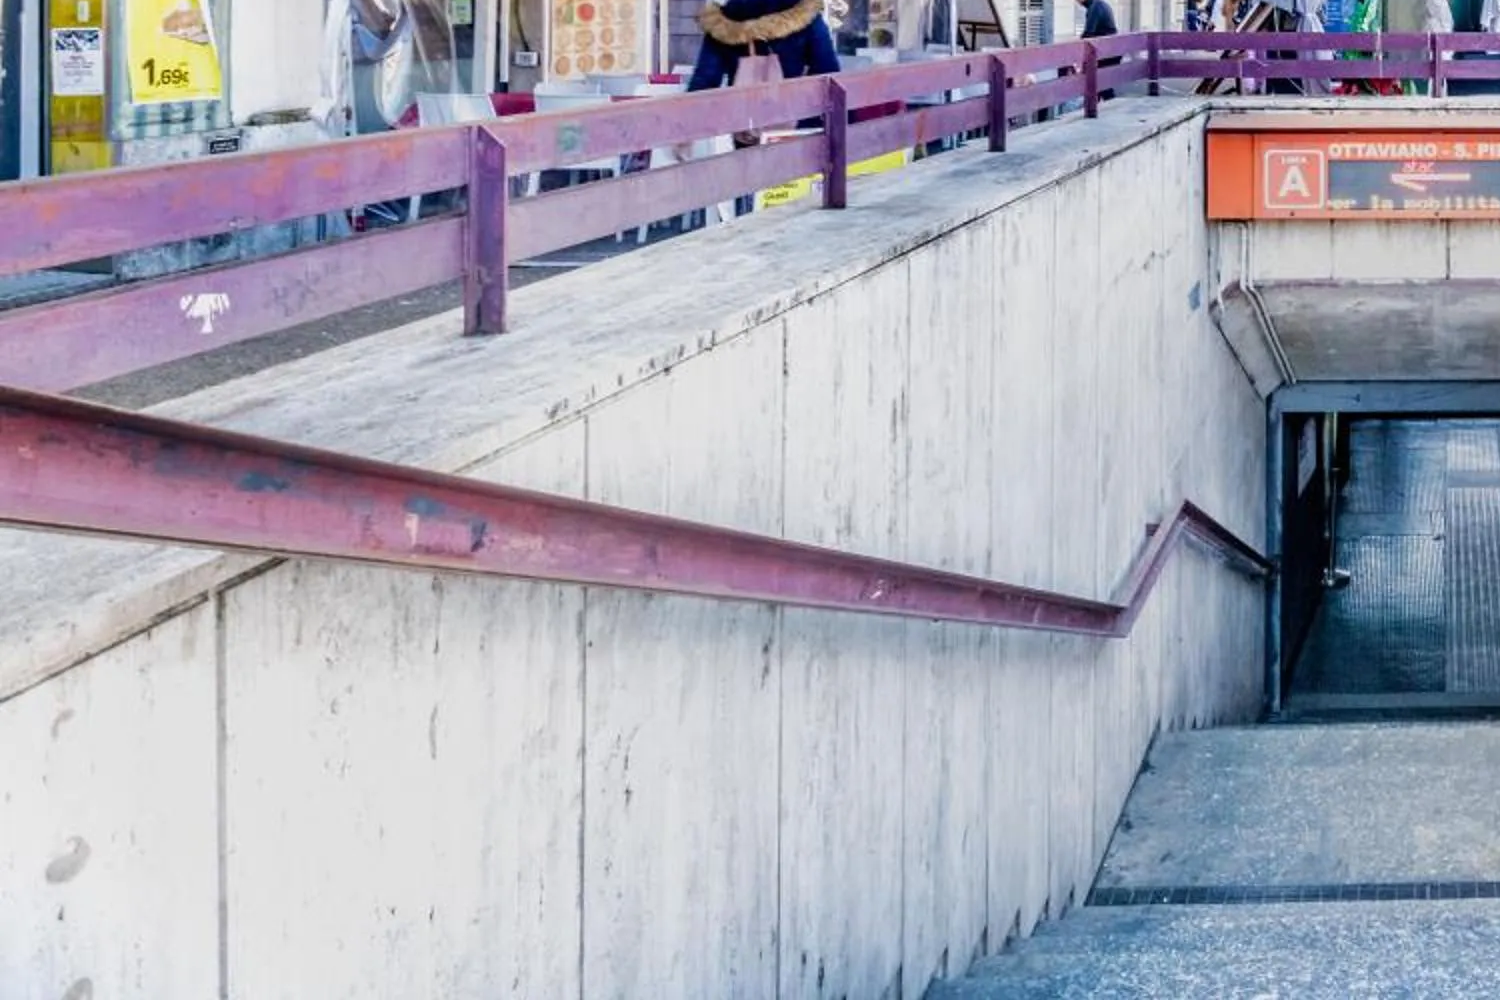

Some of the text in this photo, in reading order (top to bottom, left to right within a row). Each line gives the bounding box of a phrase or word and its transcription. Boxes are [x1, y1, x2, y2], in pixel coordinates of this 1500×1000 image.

[1328, 142, 1437, 159] OTTAVIANO
[1453, 142, 1473, 159] S.
[1279, 164, 1312, 198] A
